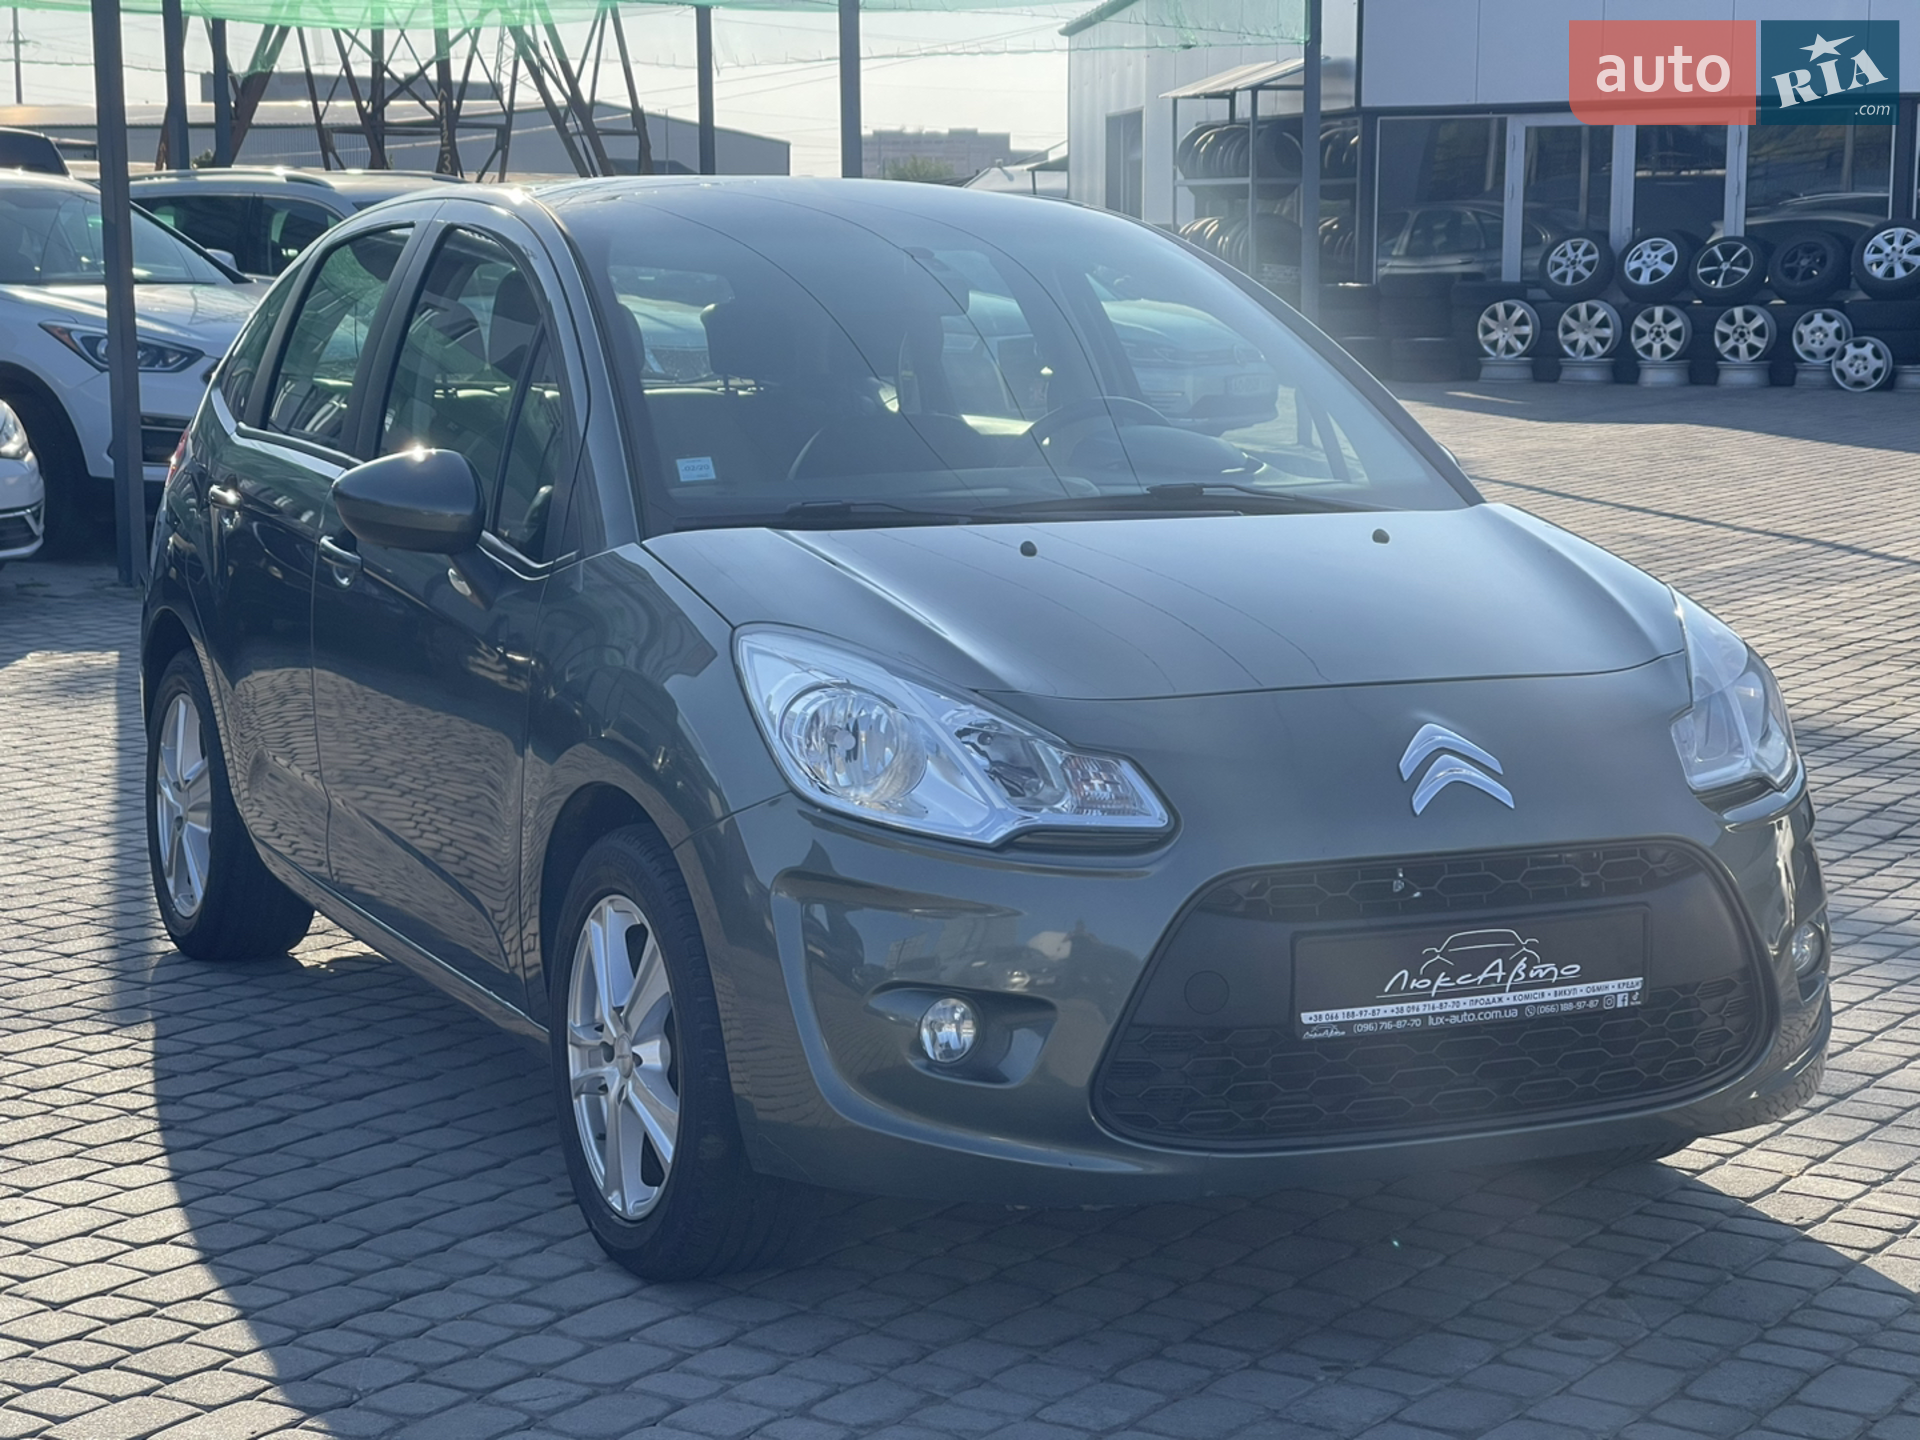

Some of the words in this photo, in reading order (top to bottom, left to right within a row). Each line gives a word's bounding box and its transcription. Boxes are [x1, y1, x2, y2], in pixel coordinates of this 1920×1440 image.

[1342, 1009, 1381, 1019] 188-97-87
[1422, 1001, 1461, 1012] 716-87-70
[1469, 996, 1504, 1007] ПРОДАЖ
[1513, 991, 1545, 1002] КОМІСІЯ
[1554, 987, 1578, 997] ВИКУП
[1586, 984, 1610, 994] ОБМІН
[1428, 1008, 1518, 1026] lux-auto.com.ua
